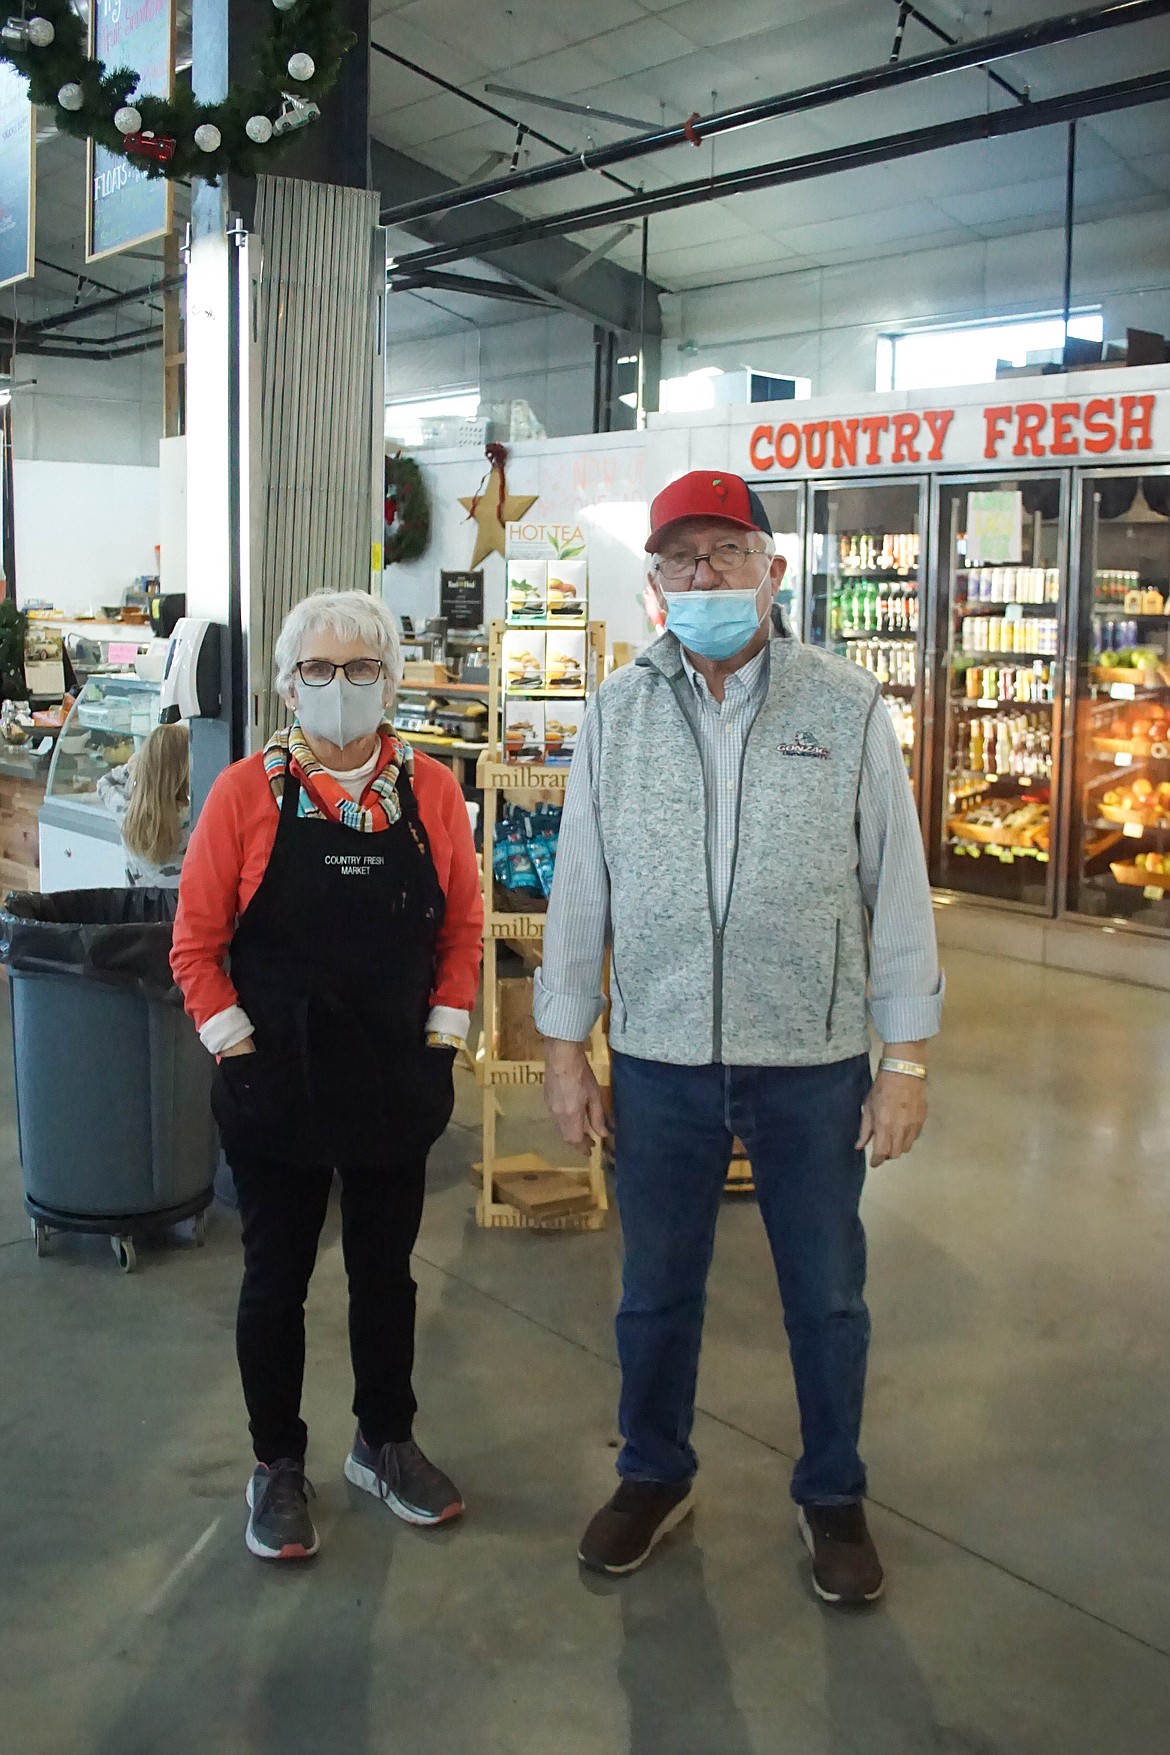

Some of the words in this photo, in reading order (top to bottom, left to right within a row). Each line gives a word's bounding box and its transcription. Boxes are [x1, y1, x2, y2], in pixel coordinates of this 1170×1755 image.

[750, 411, 952, 470] COUNTRY
[984, 396, 1155, 458] FRESH
[510, 525, 546, 541] HOT
[552, 525, 585, 542] TEA
[324, 855, 361, 865] COUNTRY
[363, 856, 384, 865] FRESH
[341, 866, 370, 875] MARKET
